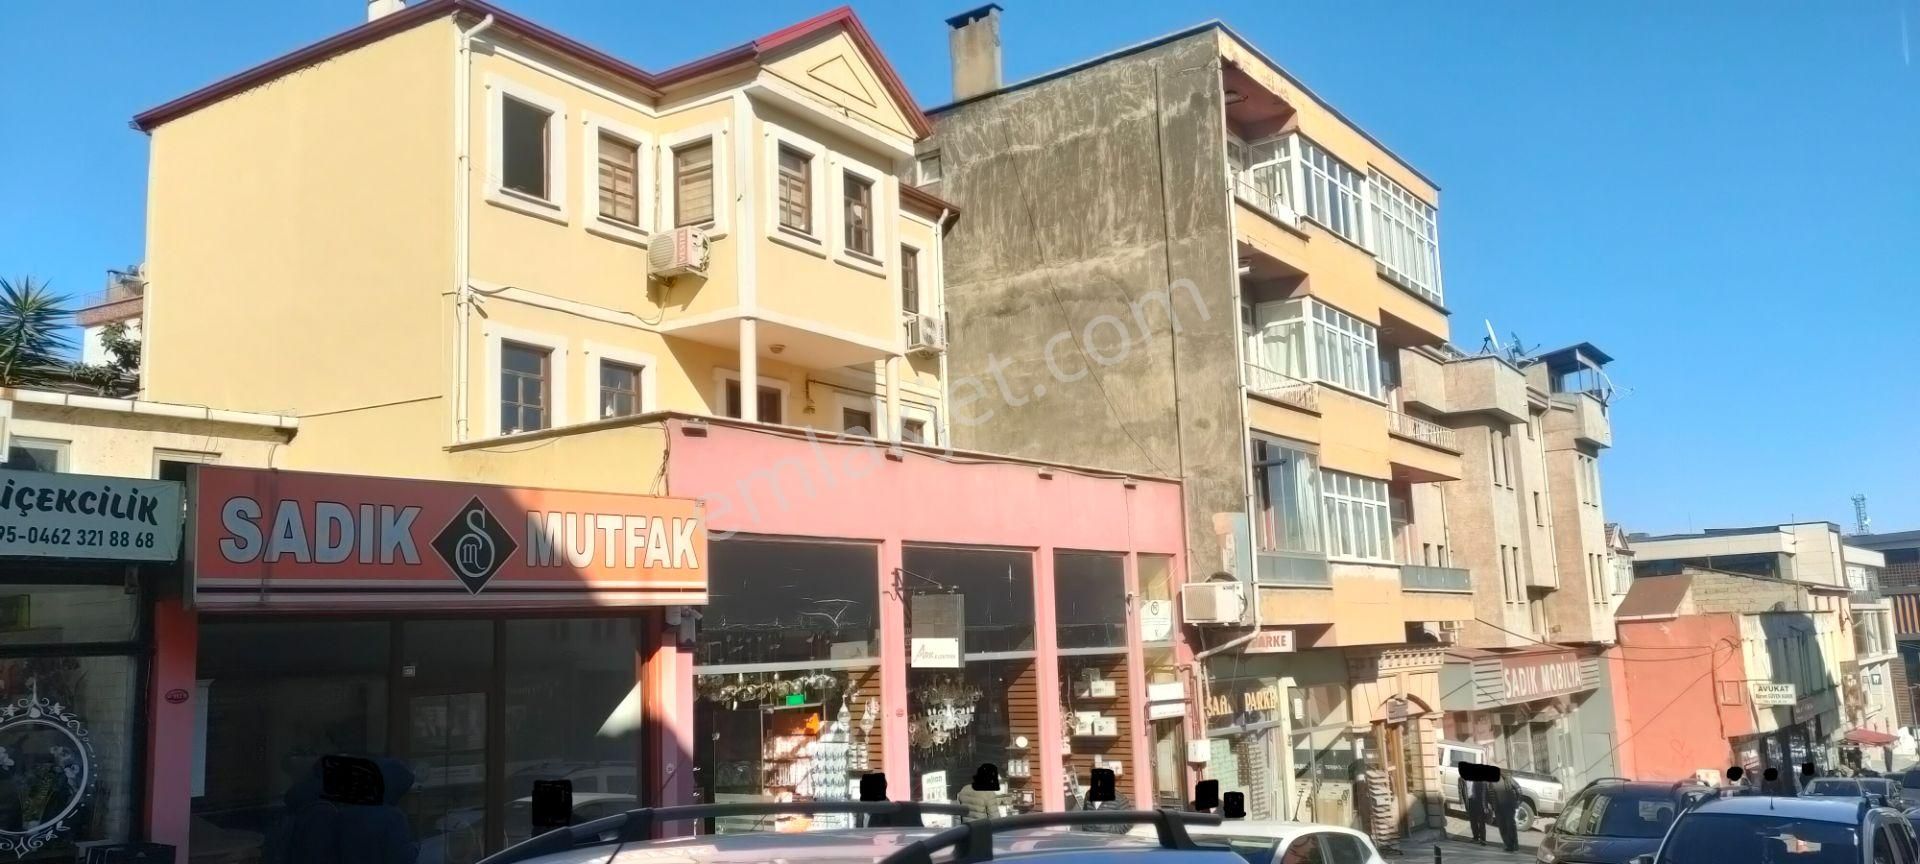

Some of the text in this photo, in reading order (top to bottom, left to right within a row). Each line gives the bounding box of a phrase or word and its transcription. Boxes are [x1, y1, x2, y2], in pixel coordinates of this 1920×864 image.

[76, 529, 103, 546] 321
[109, 531, 129, 547] 88
[135, 532, 154, 548] 68
[219, 496, 699, 569] SADIK MUTFAK
[1504, 655, 1582, 699] SADIK MOBİLYA
[1244, 689, 1276, 712] PARKE
